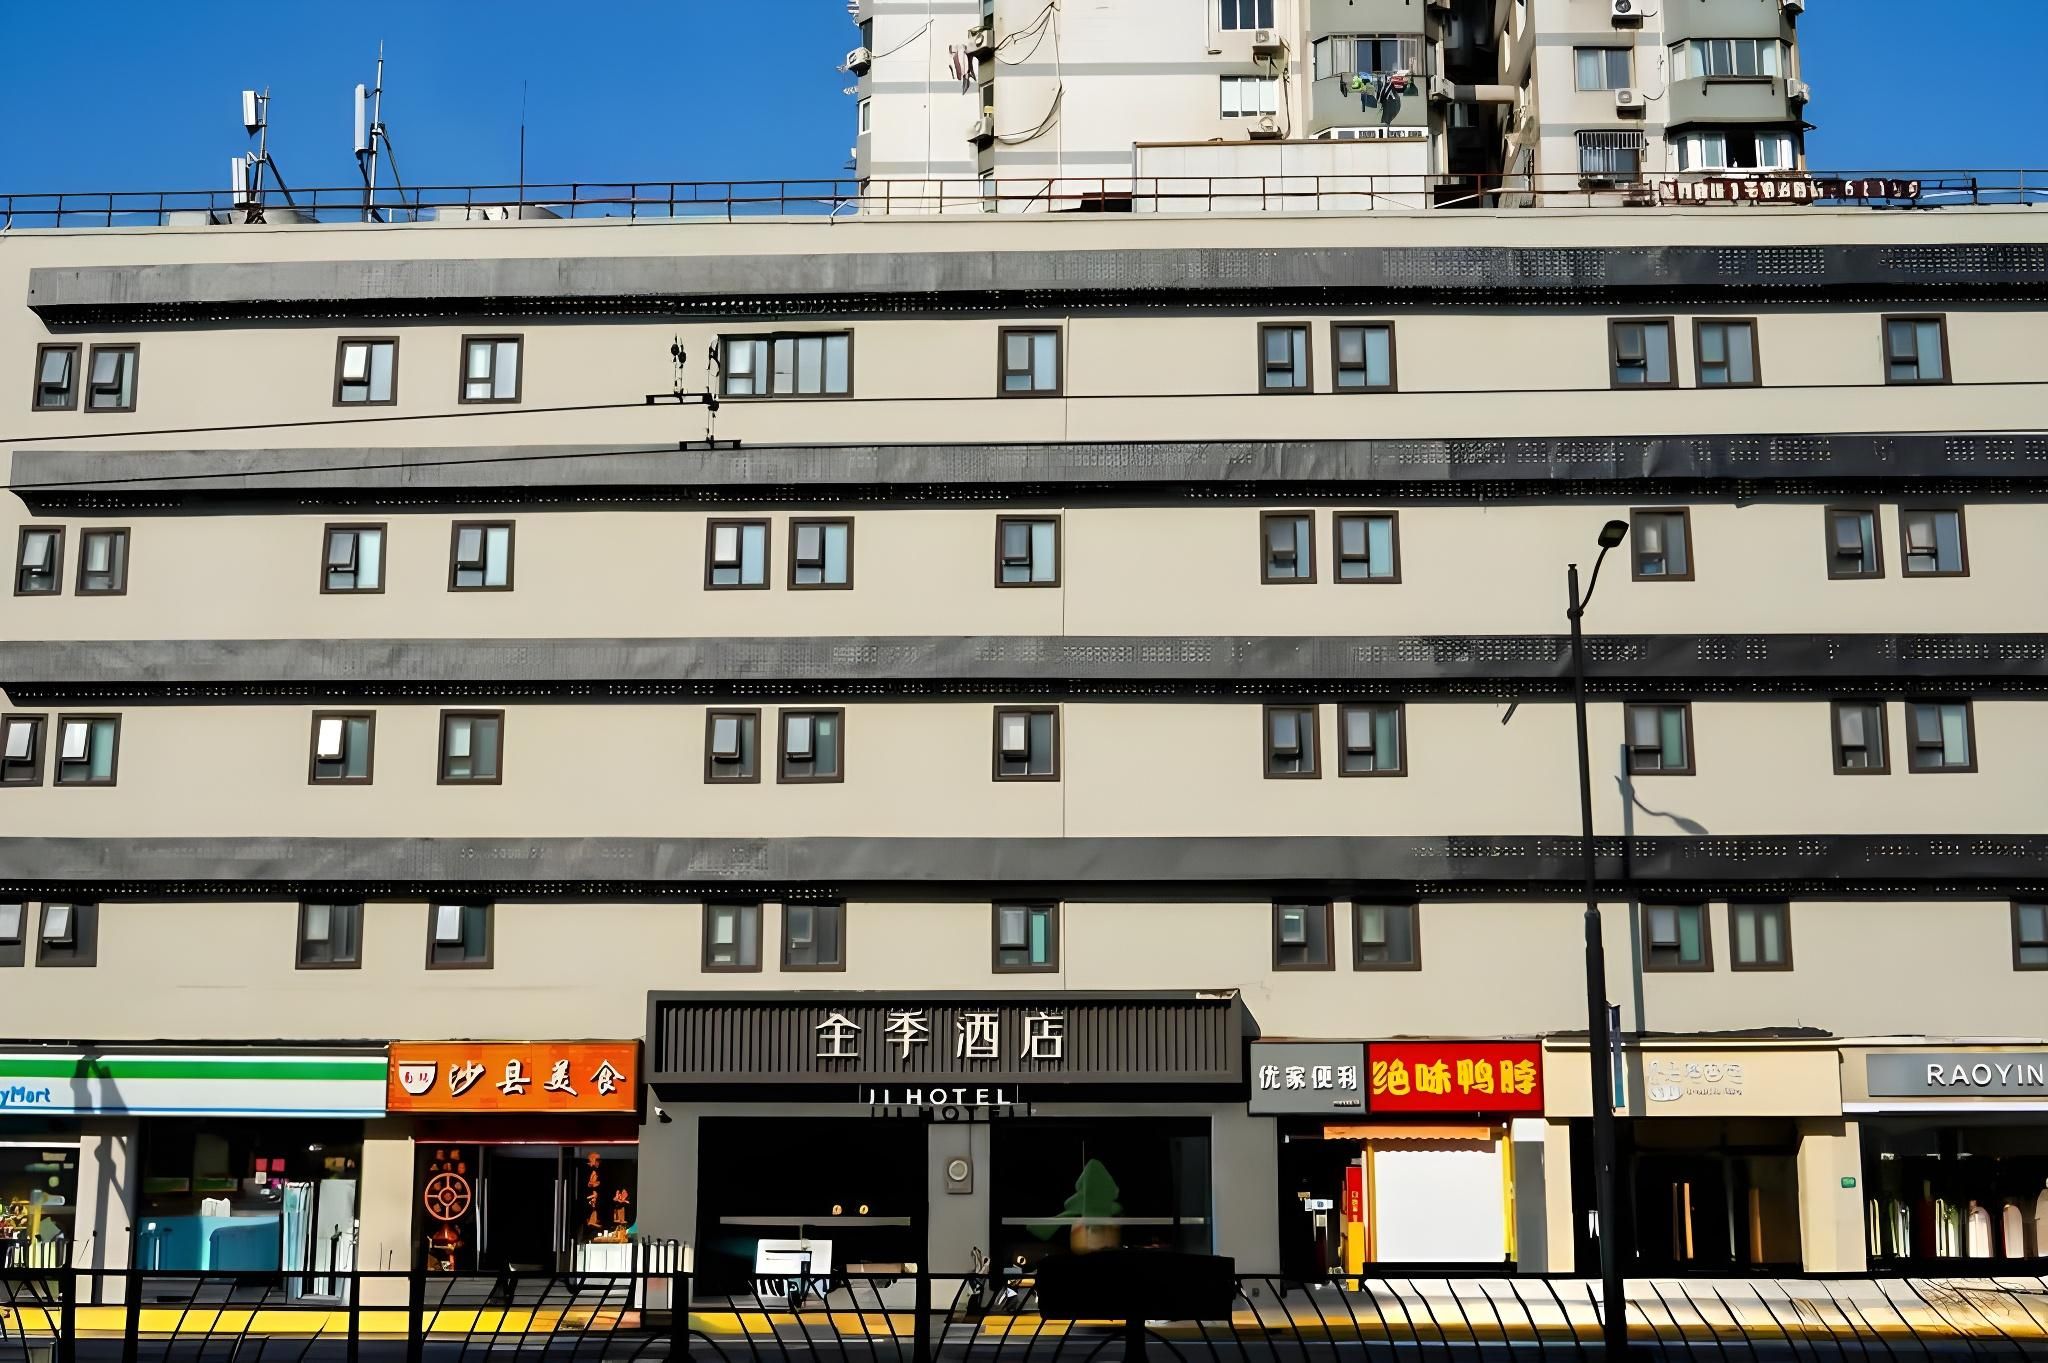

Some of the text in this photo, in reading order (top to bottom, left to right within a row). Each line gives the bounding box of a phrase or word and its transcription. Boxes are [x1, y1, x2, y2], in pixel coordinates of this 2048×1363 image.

[815, 1012, 1063, 1059] 全季酒店
[448, 1059, 626, 1096] 沙县美食
[1259, 1065, 1358, 1090] 优家便利
[1372, 1058, 1537, 1095] 绝味鸭脖
[1927, 1063, 2045, 1087] RAOYIN
[869, 1087, 1011, 1106] JI HOTEL
